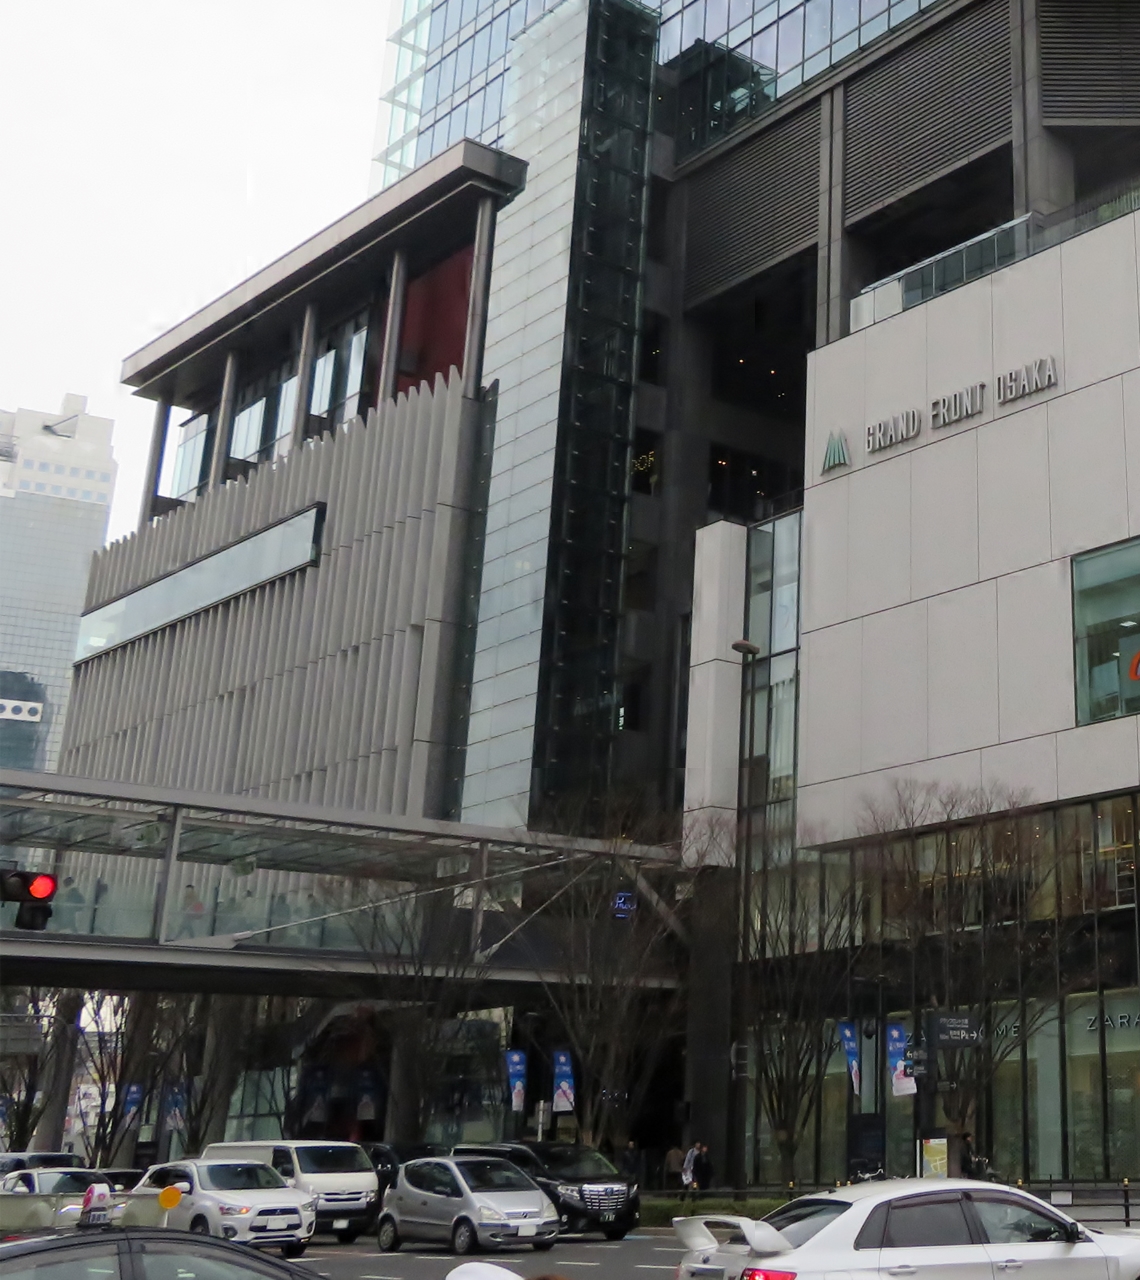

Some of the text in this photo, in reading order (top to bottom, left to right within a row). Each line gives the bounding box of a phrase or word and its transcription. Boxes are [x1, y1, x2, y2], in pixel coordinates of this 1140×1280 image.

[865, 354, 1058, 453] GRAND FRONT OSAKA
